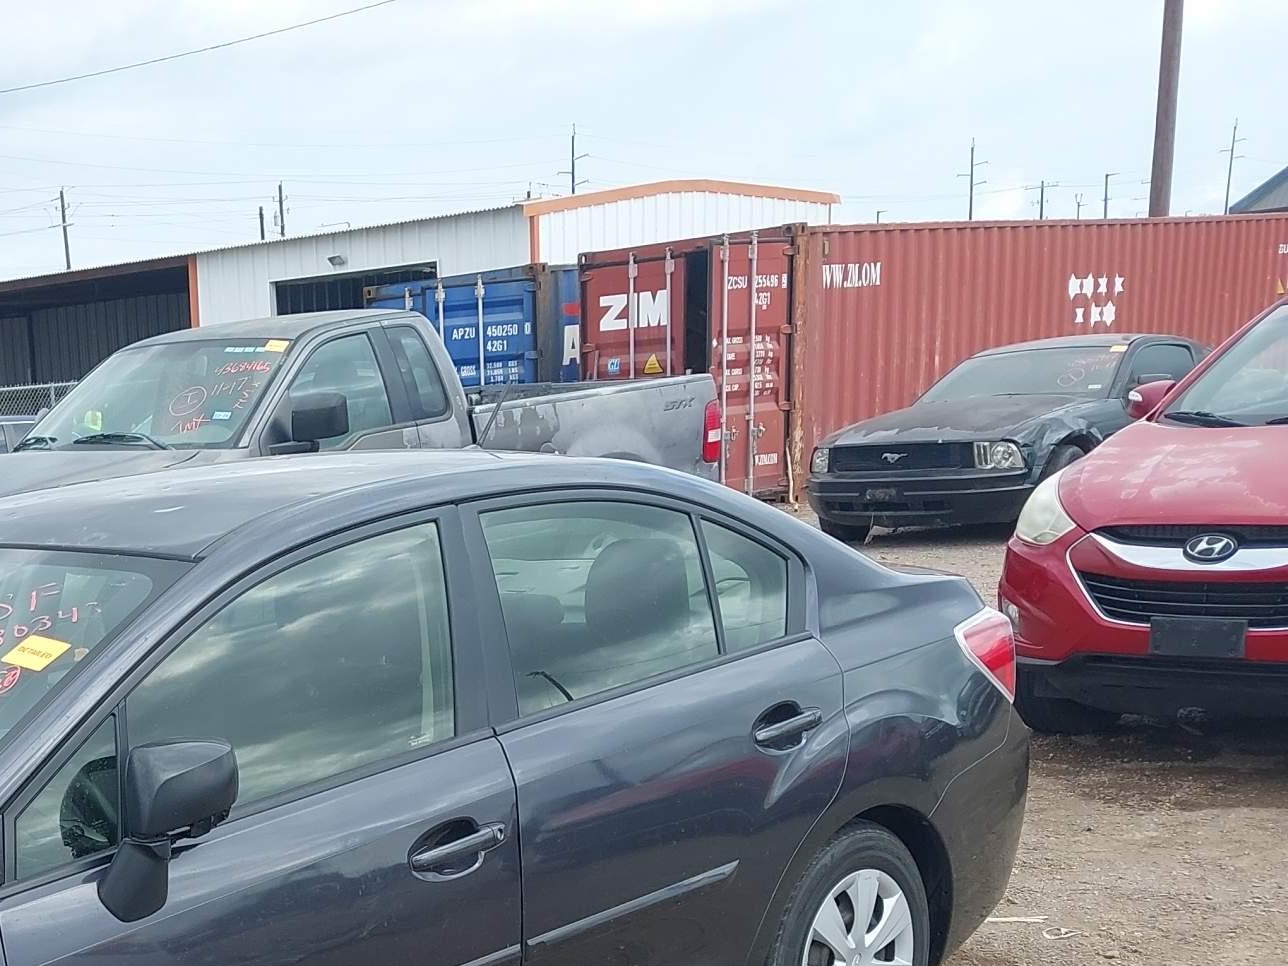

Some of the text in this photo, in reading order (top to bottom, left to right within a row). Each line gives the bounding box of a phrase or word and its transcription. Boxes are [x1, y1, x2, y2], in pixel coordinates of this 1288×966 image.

[727, 276, 748, 290] ZCSU
[599, 289, 668, 332] ZIM
[452, 327, 476, 341] APZU
[486, 324, 518, 338] 450250
[486, 340, 508, 352] 42G1
